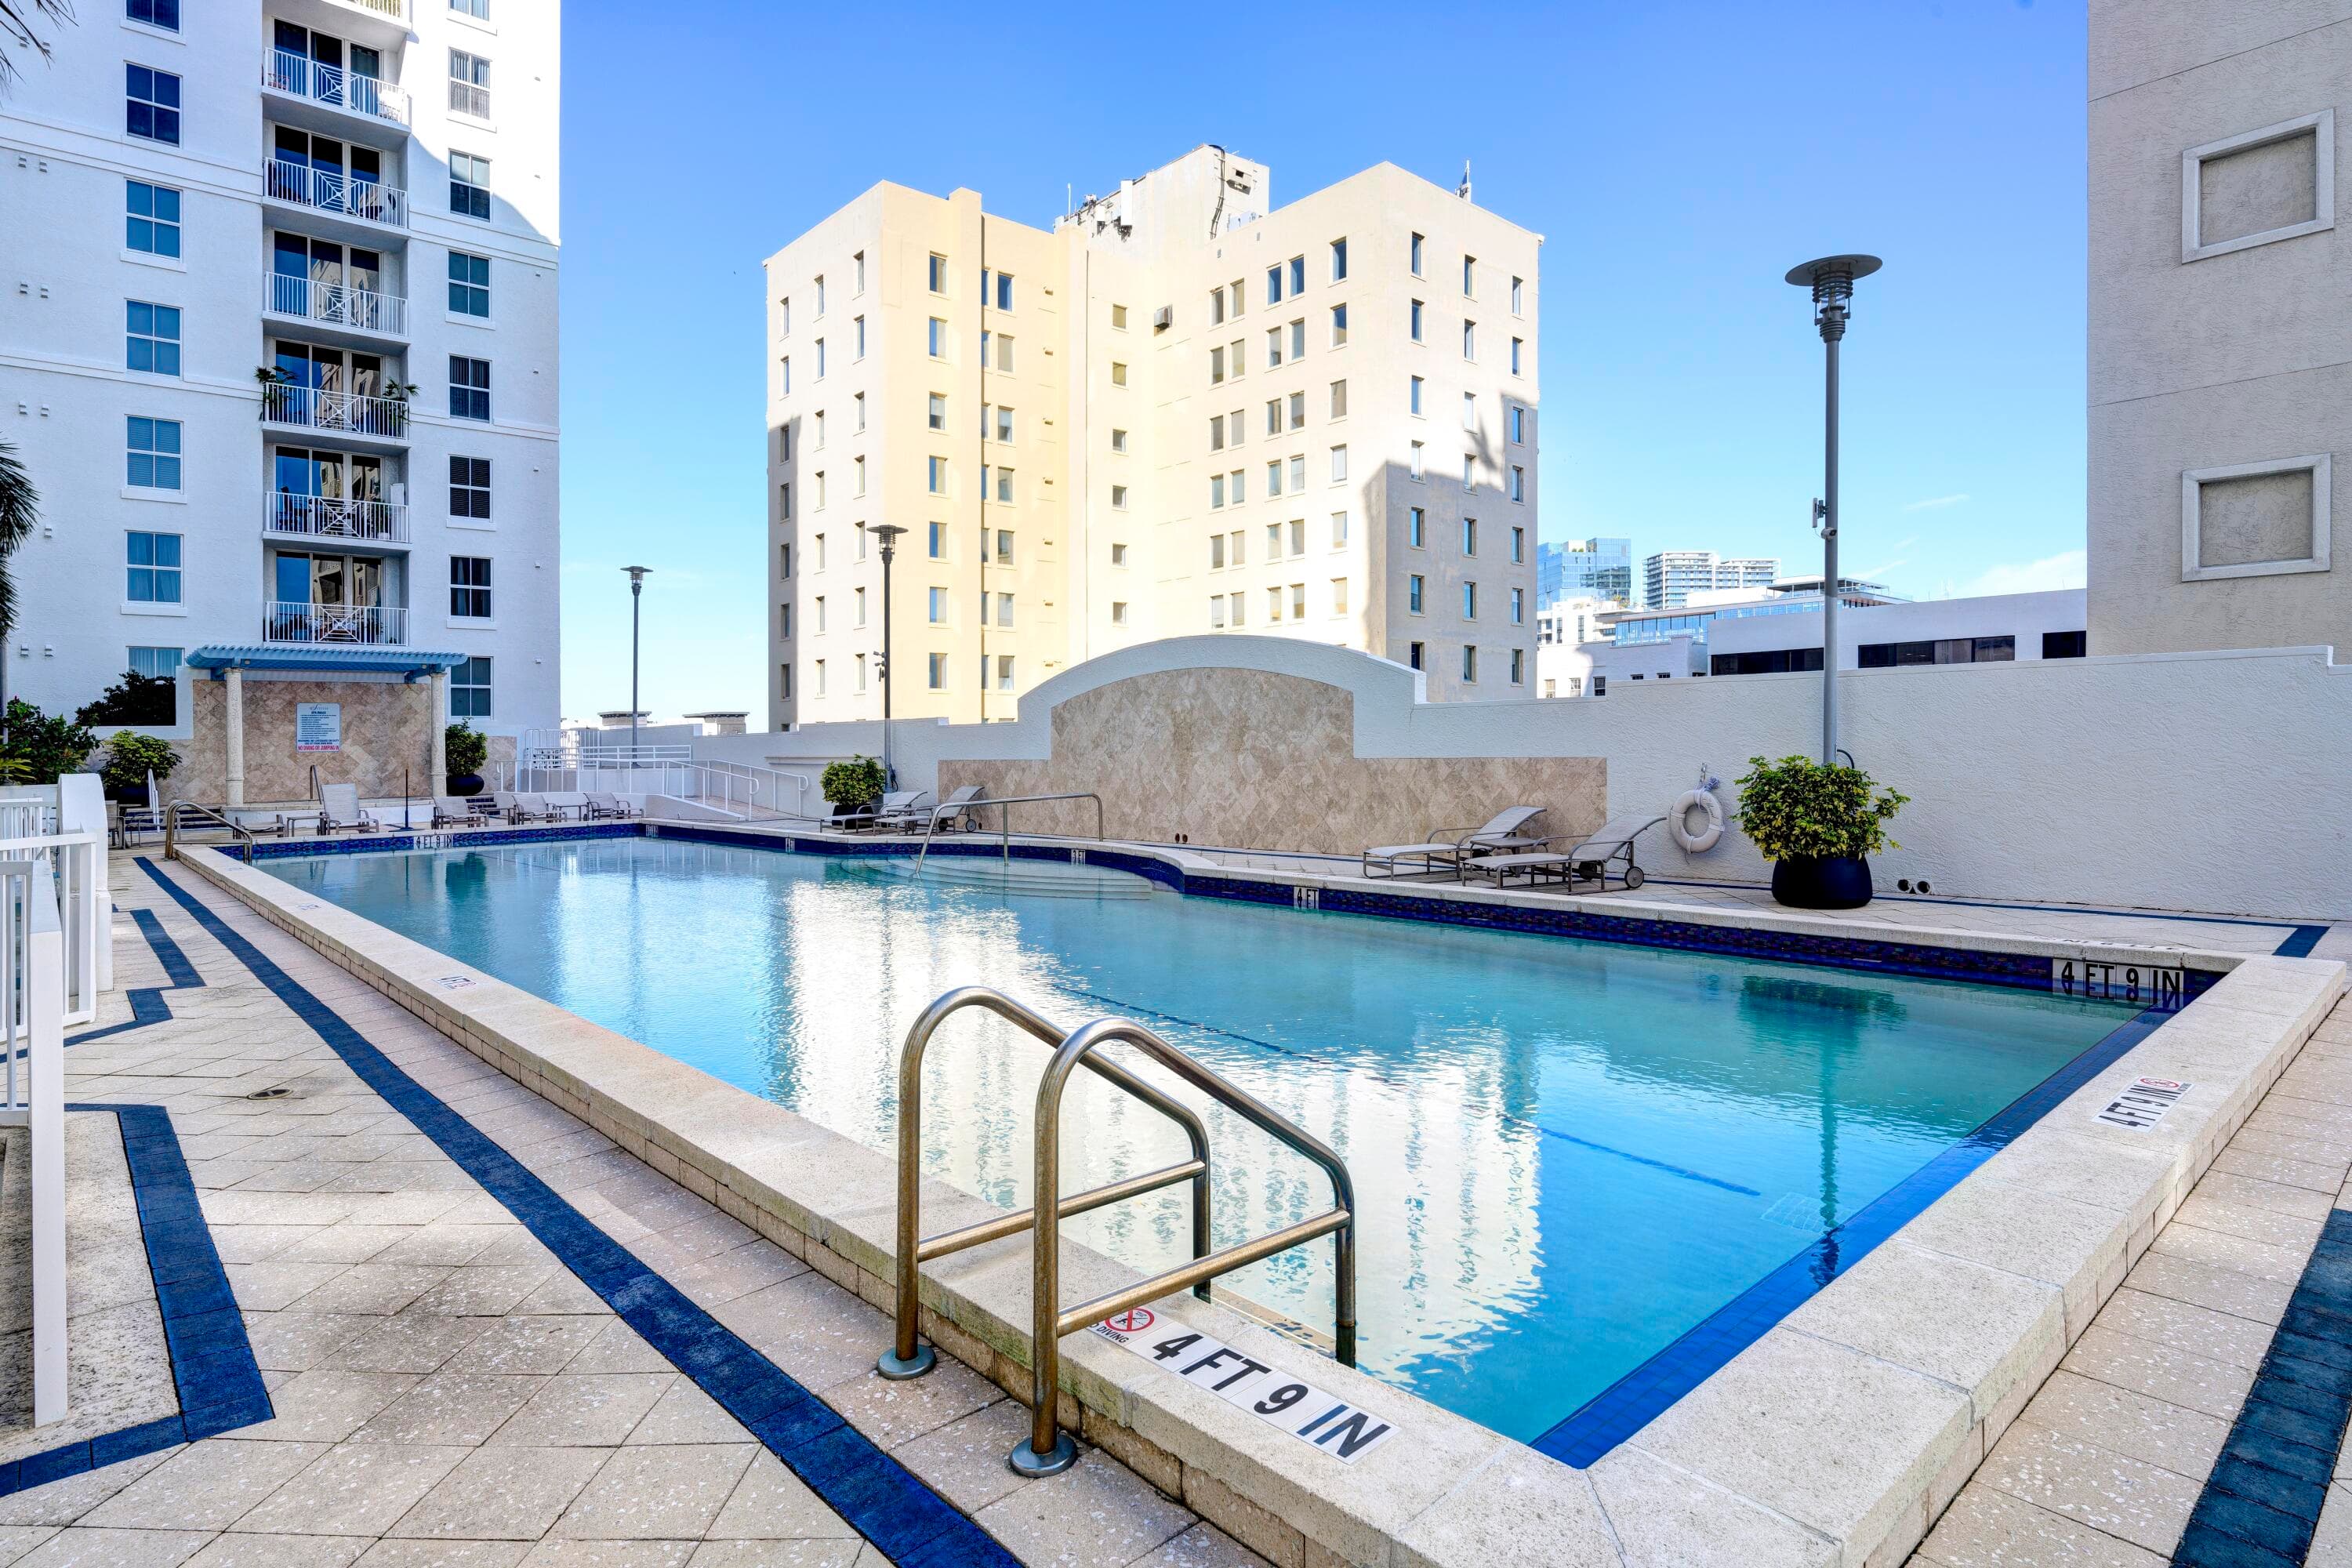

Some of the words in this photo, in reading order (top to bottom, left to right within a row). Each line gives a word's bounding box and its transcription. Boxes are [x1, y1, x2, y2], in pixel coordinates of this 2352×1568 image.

[2061, 961, 2074, 981] 4
[2085, 964, 2114, 983] FT
[2126, 968, 2140, 986] 9
[2153, 970, 2180, 991] IN
[2128, 1084, 2181, 1100] IN
[2121, 1097, 2169, 1107] 9
[2105, 1102, 2161, 1121] FT
[2099, 1116, 2150, 1127] 4
[1098, 1326, 1129, 1343] DIVING
[1152, 1334, 1203, 1361] 4
[1179, 1348, 1272, 1392] FT
[1254, 1384, 1308, 1414] 9
[1297, 1404, 1391, 1458] IN
